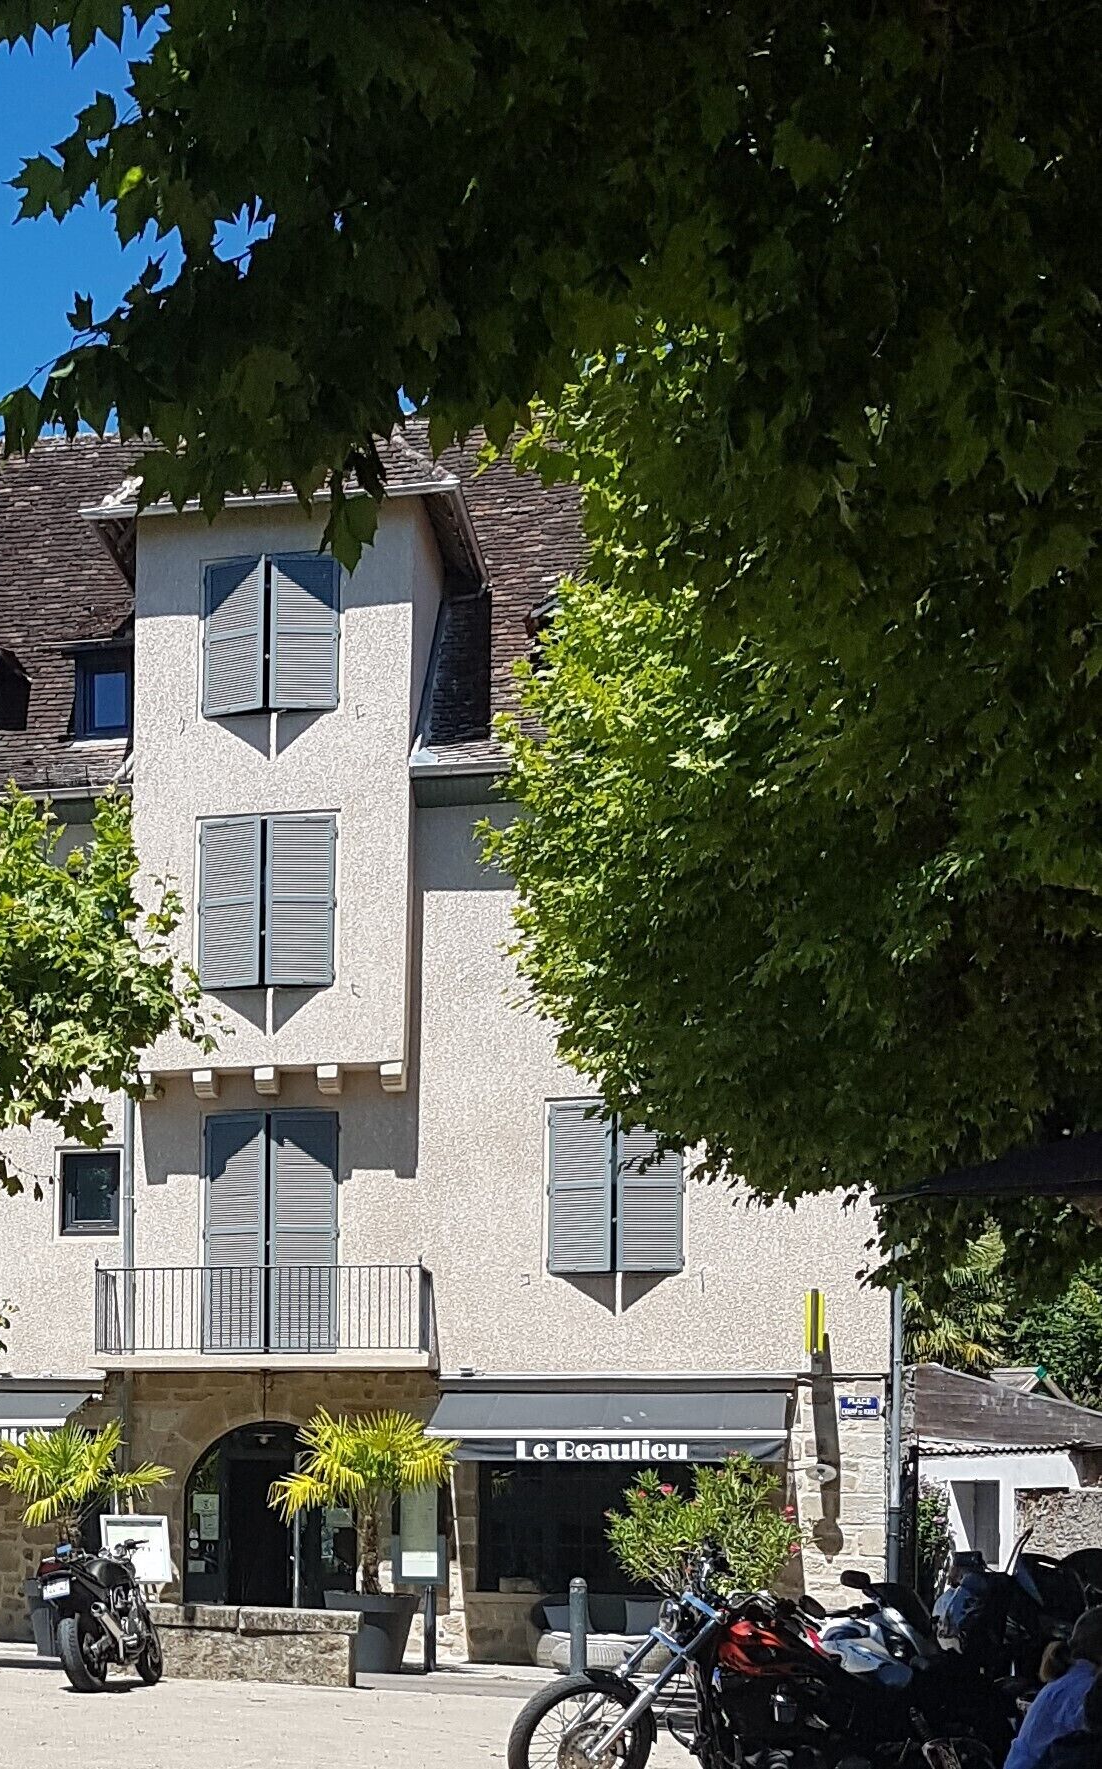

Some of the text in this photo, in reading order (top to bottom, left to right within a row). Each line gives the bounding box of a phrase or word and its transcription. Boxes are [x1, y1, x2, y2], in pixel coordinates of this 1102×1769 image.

[847, 1397, 872, 1405] PLACE
[516, 1440, 688, 1460] Le Beaulieu
